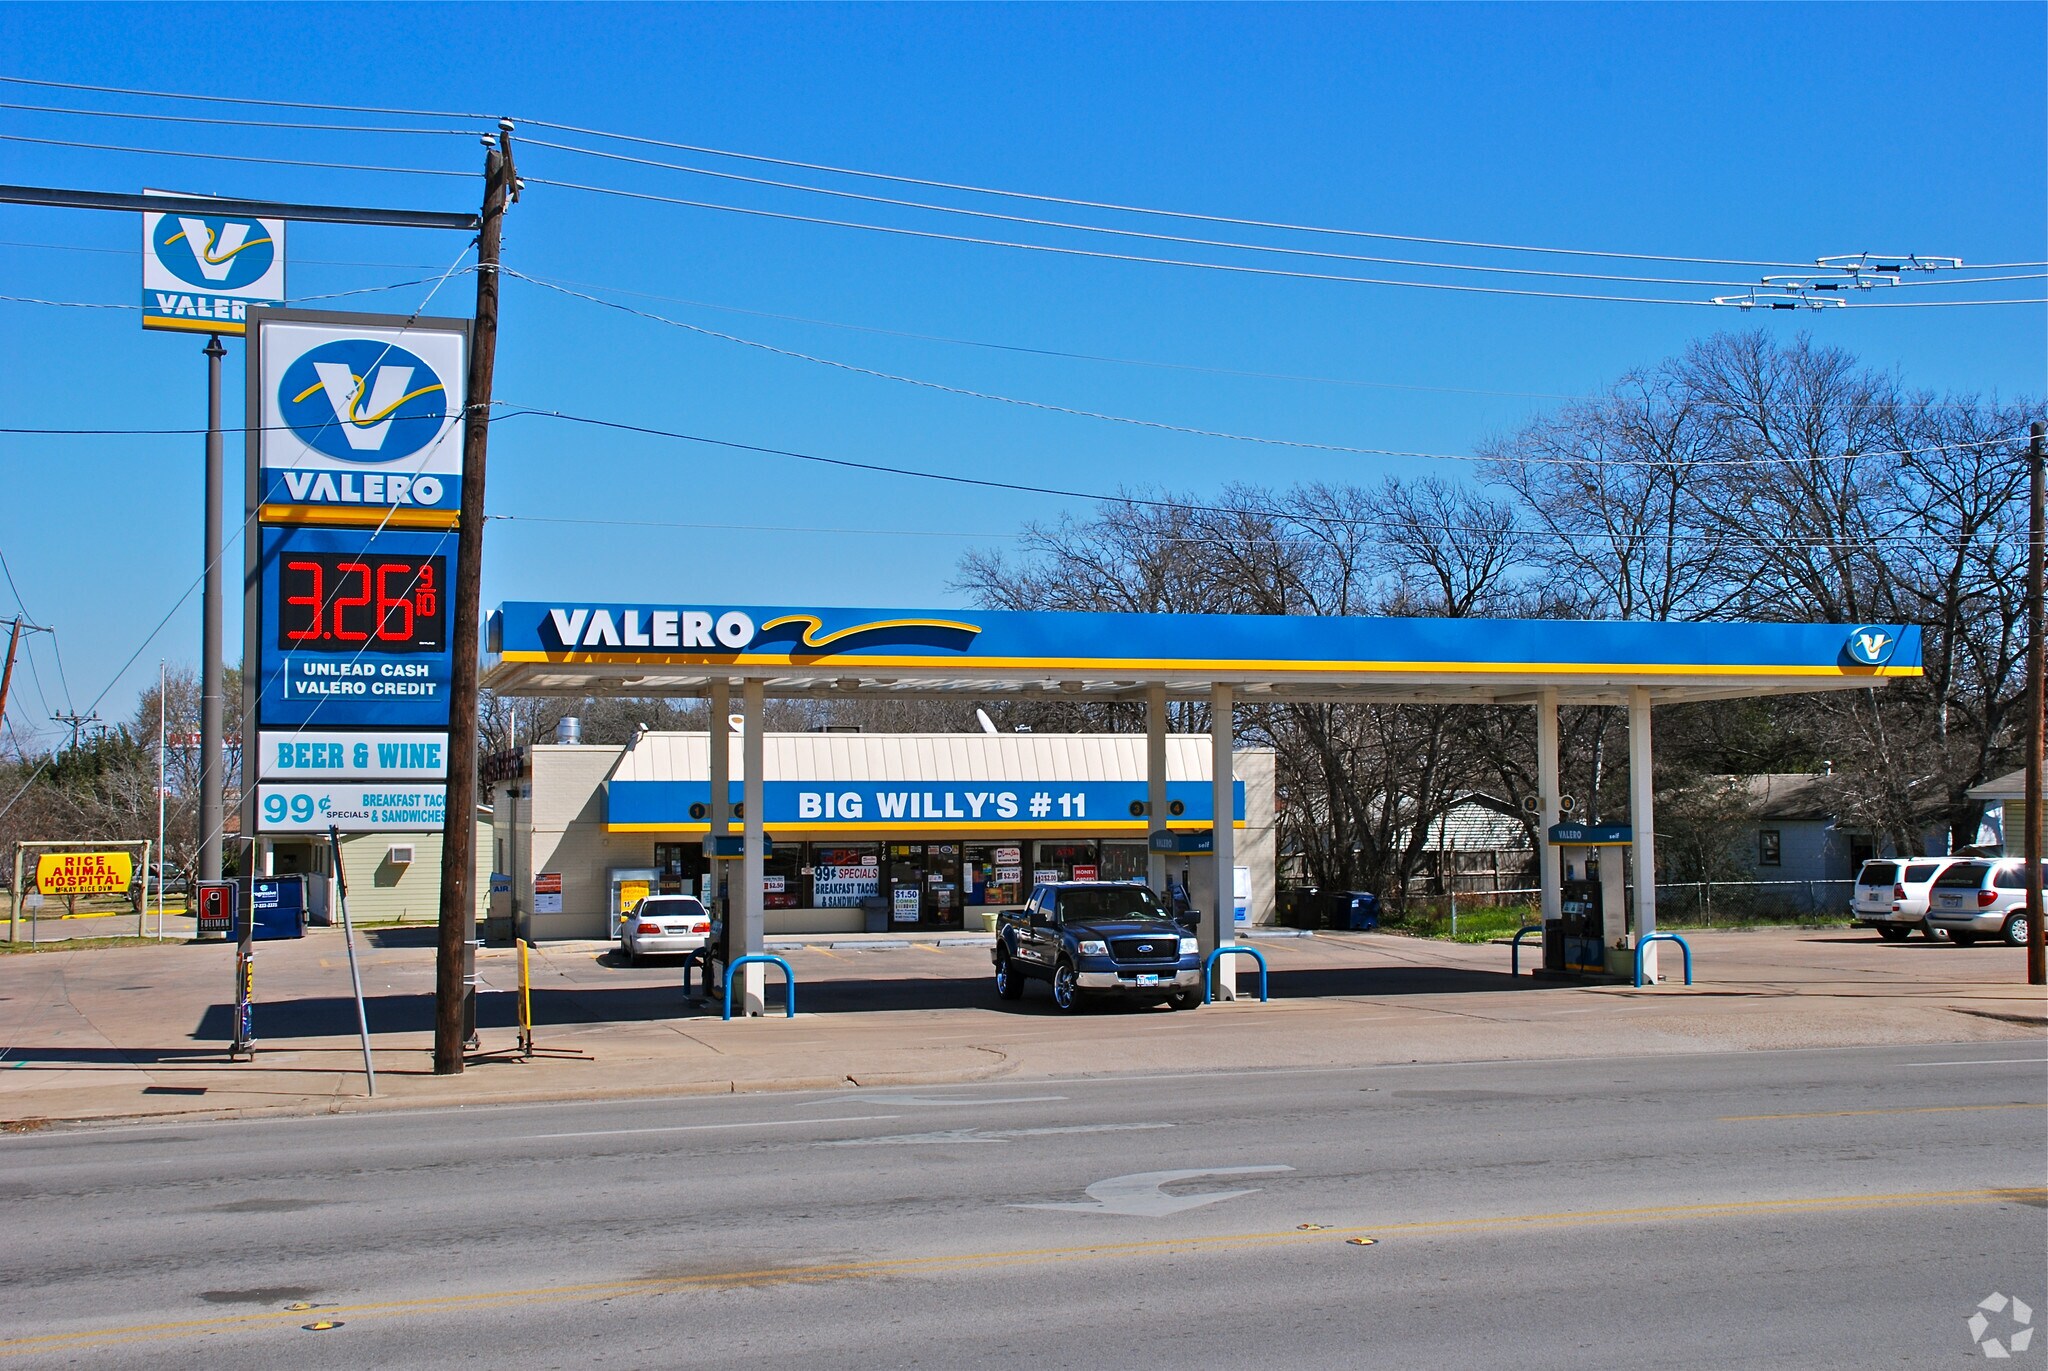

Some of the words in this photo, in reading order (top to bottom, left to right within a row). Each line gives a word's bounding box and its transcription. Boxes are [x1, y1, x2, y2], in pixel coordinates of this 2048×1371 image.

[156, 293, 270, 321] VALER
[283, 471, 444, 505] VALERO
[287, 562, 414, 641] 3.26
[550, 608, 755, 648] VALERO
[303, 663, 376, 676] UNLEAD
[380, 664, 429, 677] CASH
[295, 681, 367, 694] VALERO
[371, 682, 437, 695] CREDIT
[278, 743, 344, 769] BEER
[353, 743, 368, 769] &
[377, 743, 441, 769] WINE
[362, 794, 419, 807] BREAKFAST
[799, 792, 863, 818] BIG
[876, 792, 1018, 819] WILLY'S
[264, 793, 332, 824] 99¢
[326, 811, 369, 819] SPECIALS
[371, 809, 379, 823] &
[1558, 830, 1582, 839] VALERO
[1198, 841, 1211, 849] self
[65, 856, 104, 866] RICE
[53, 866, 116, 876] ANIMAL
[839, 868, 878, 878] SPECIALS
[1003, 872, 1019, 880] $2.99
[45, 875, 124, 887] HOSPITAL
[815, 883, 853, 894] BREAKFAST
[856, 883, 878, 894] TACOS
[895, 890, 917, 898] $1.50
[821, 896, 827, 907] &
[828, 896, 870, 907] SANDWICH
[200, 919, 230, 928] FUELMAN
